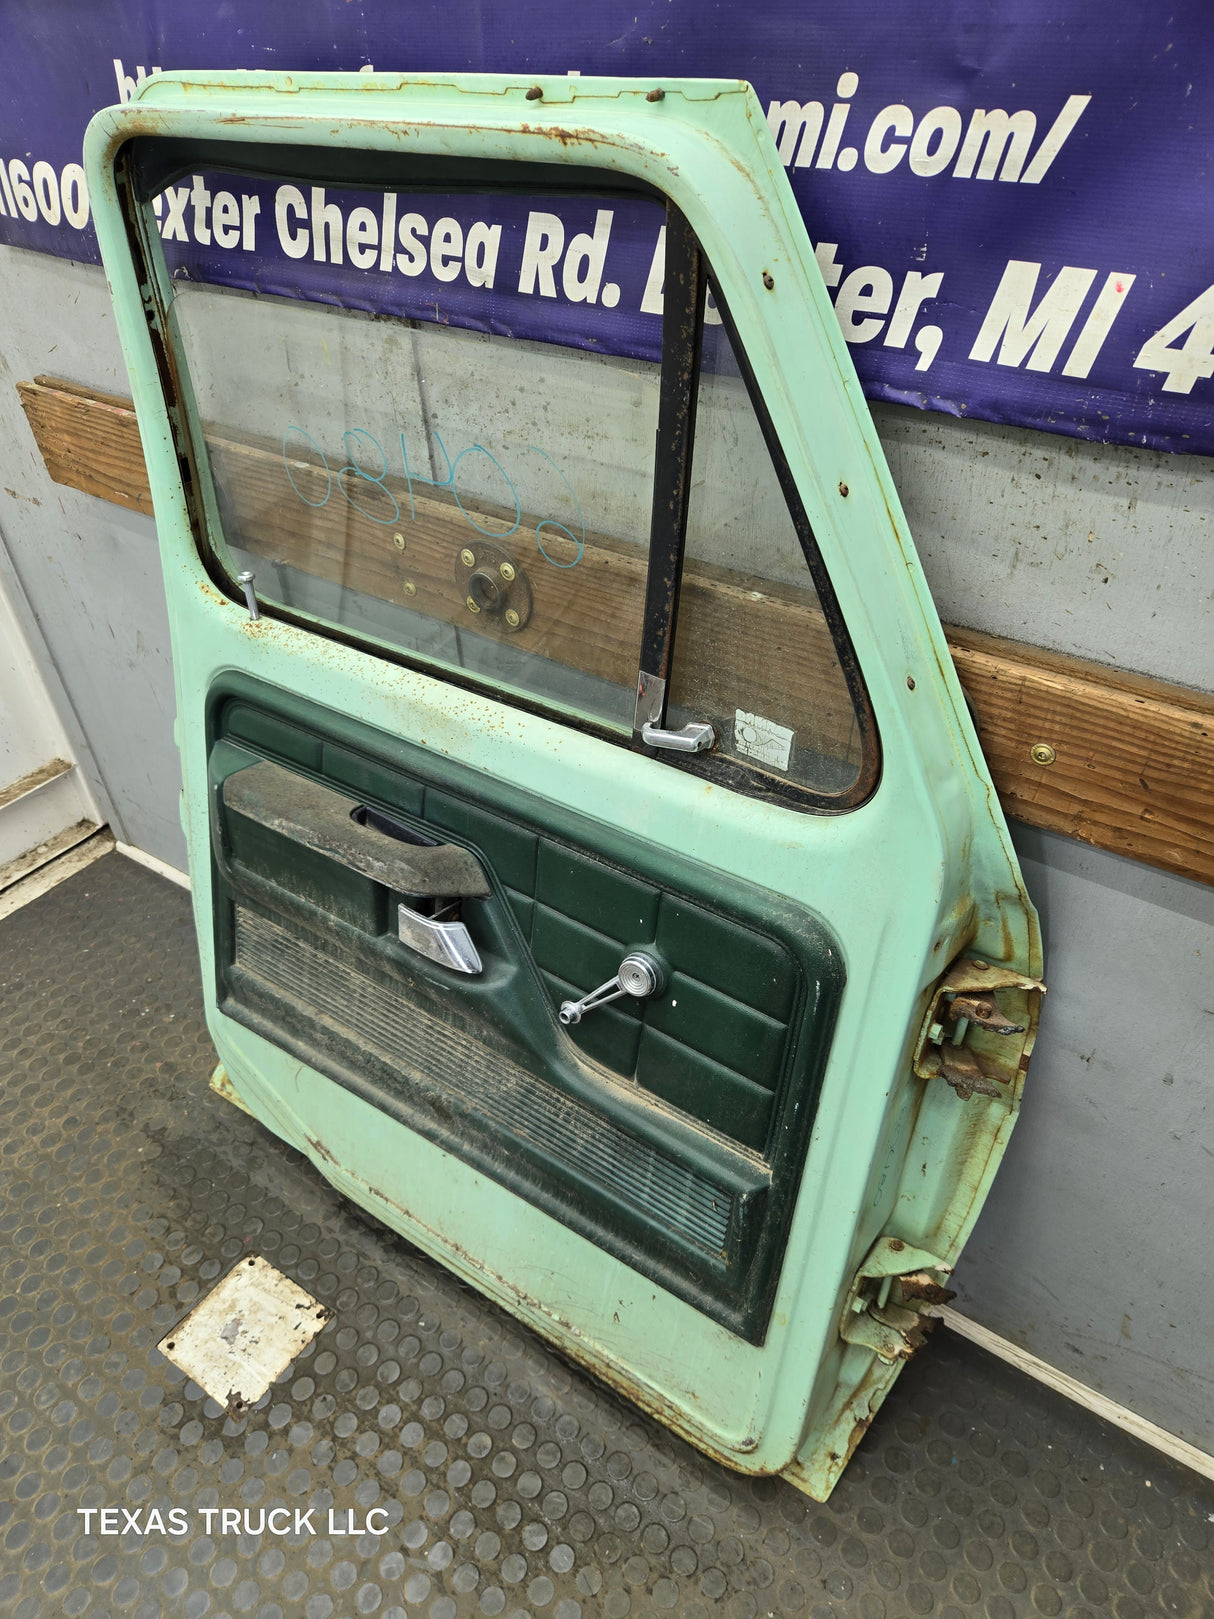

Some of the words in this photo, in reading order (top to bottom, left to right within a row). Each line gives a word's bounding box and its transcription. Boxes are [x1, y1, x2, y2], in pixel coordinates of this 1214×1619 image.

[0, 158, 90, 230] 1600
[275, 185, 502, 289] Chelsea
[518, 209, 621, 308] Rd.
[968, 259, 1137, 379] MI
[1132, 284, 1214, 395] 4
